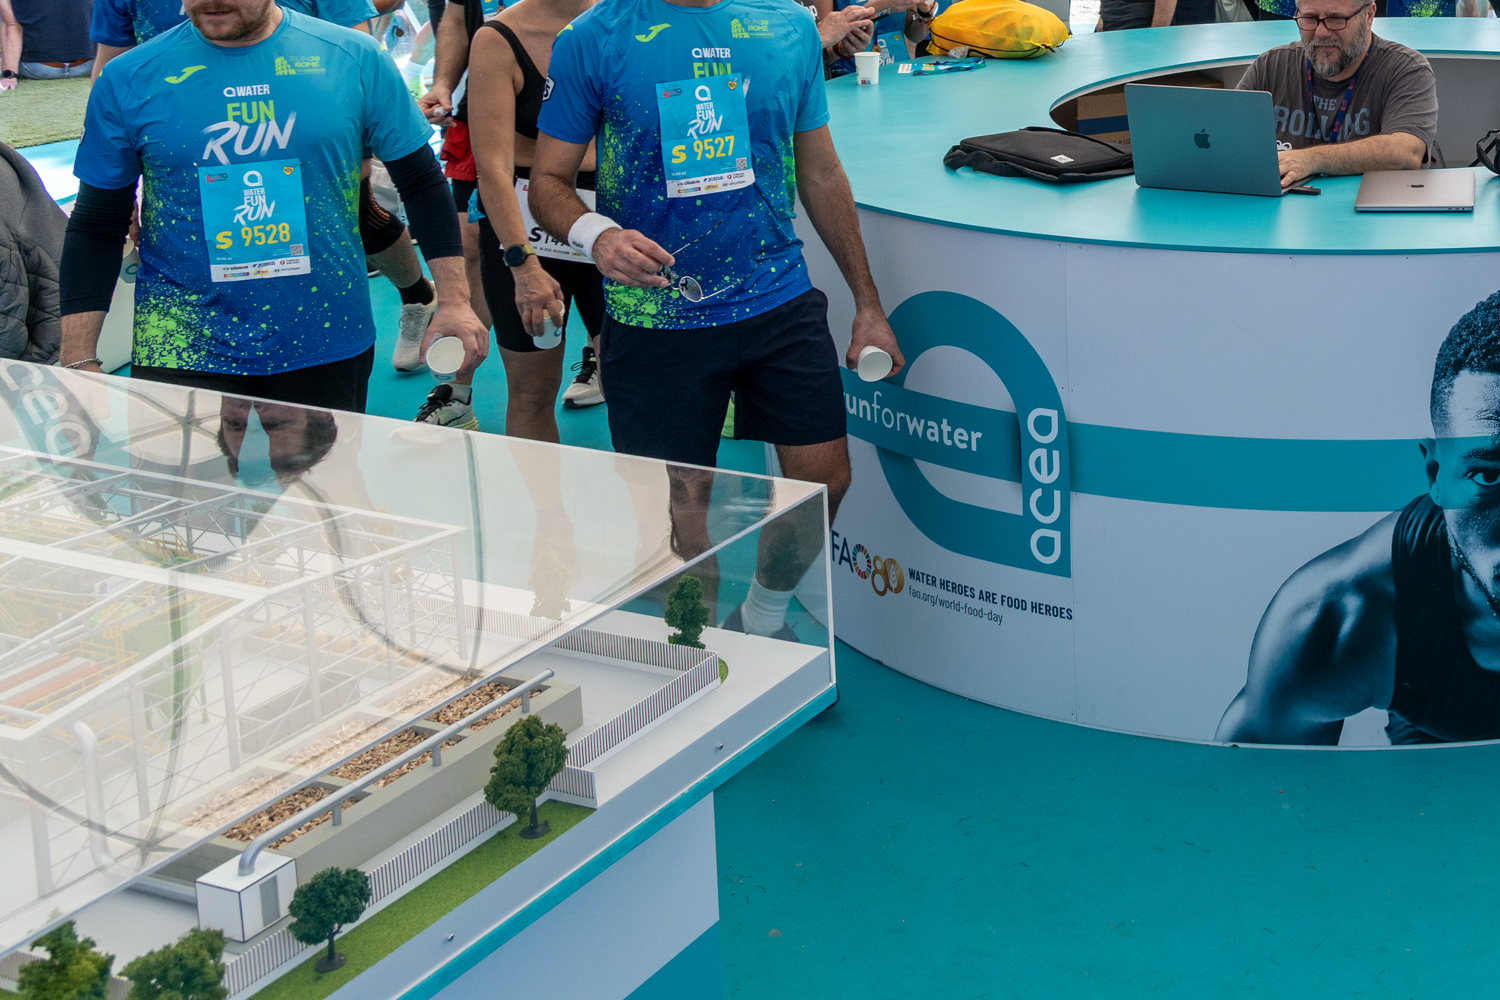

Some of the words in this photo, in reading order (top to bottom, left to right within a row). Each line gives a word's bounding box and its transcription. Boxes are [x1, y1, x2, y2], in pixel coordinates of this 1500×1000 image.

[702, 48, 731, 58] WATER
[236, 84, 270, 96] WATER
[1313, 95, 1337, 111] THE
[226, 100, 275, 124] FUN
[696, 108, 715, 120] FUN
[200, 110, 298, 166] RUN
[686, 114, 723, 141] RUN
[671, 144, 687, 164] S
[693, 136, 735, 161] 9527
[243, 188, 266, 197] WATER
[244, 194, 266, 206] FUN
[232, 200, 276, 227] RUN
[216, 230, 233, 250] S
[240, 222, 290, 247] 9528
[1028, 407, 1062, 565] acea
[908, 567, 937, 589] WATER
[940, 576, 976, 598] HEROES
[978, 588, 998, 604] ARE
[1001, 594, 1028, 612] FOOD
[1031, 600, 1073, 620] HEROES
[908, 585, 1004, 626] fao.org/world-food-day
